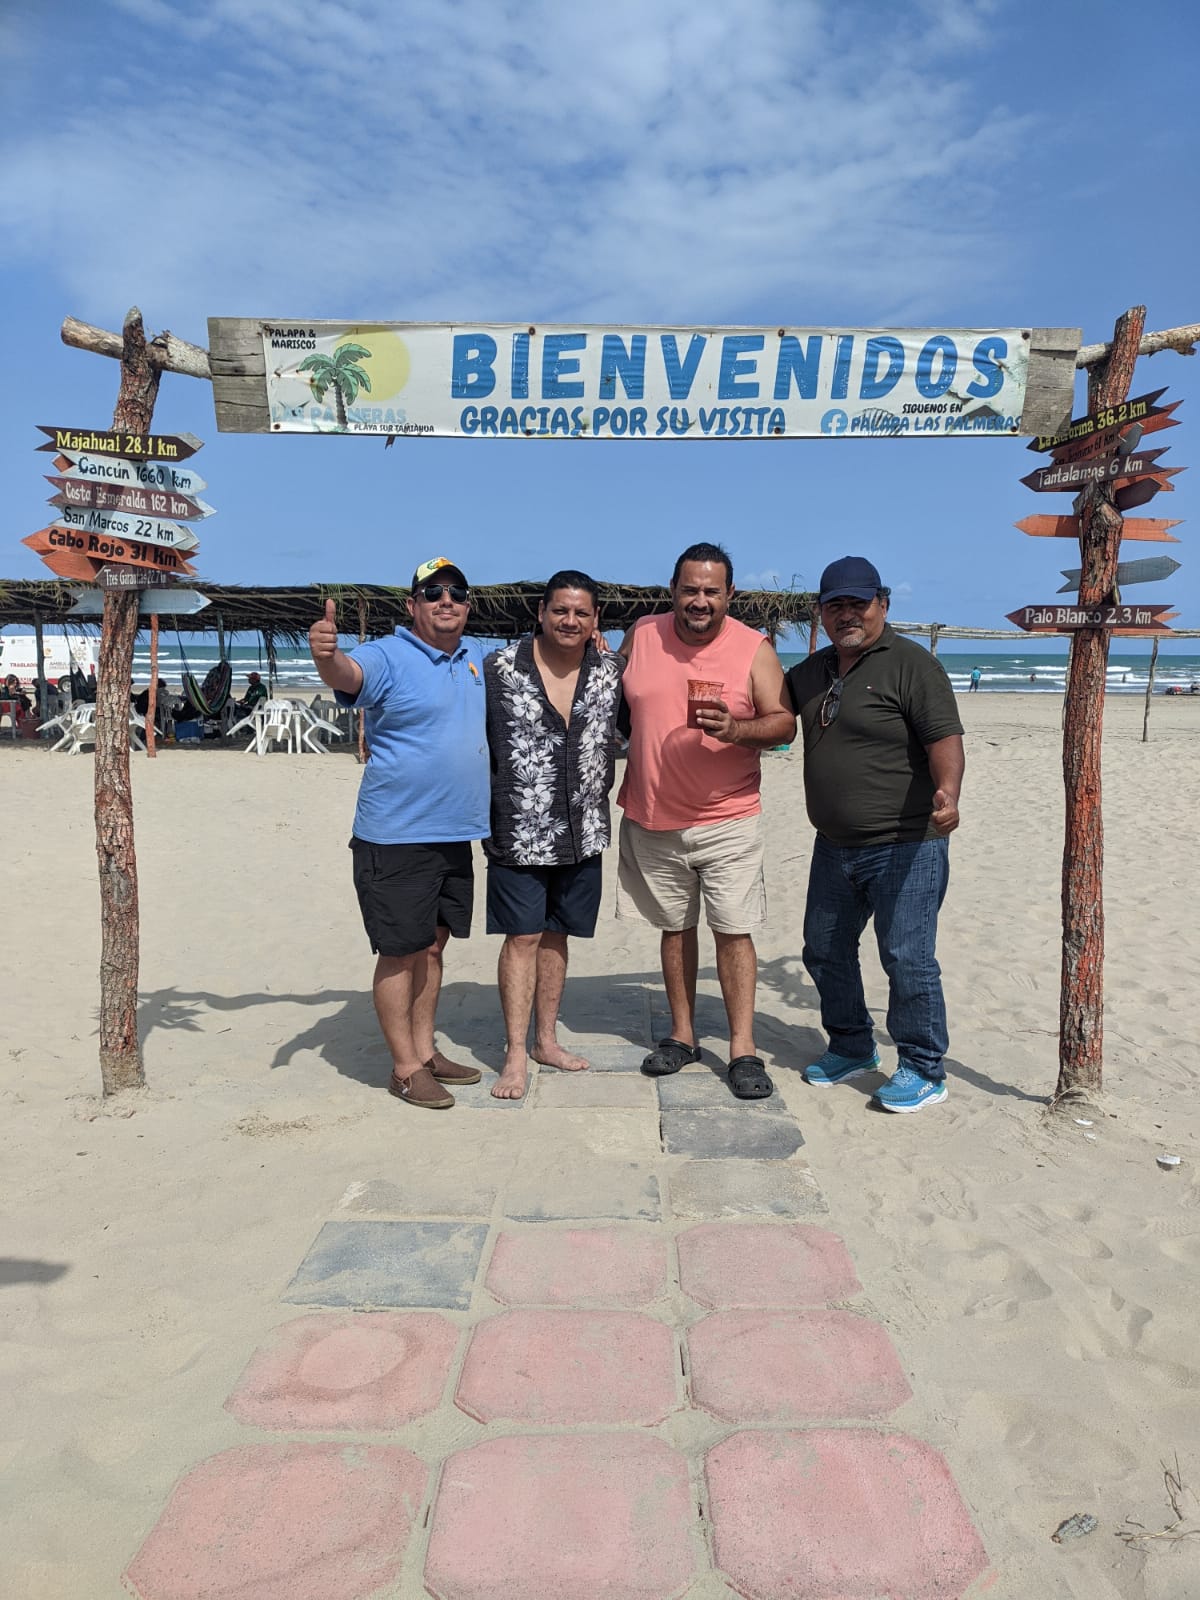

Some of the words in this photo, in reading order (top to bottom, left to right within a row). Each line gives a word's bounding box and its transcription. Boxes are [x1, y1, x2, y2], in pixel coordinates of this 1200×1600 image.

[269, 329, 306, 338] PALAPA
[308, 330, 316, 338] &
[271, 339, 316, 349] MARISCOS
[451, 332, 1008, 400] BIENVENIDOS
[310, 406, 407, 424] PAMERAS
[902, 403, 947, 414] SIGUENOS
[950, 403, 964, 413] EN
[1097, 405, 1127, 430] 36.2
[1129, 401, 1148, 419] km
[354, 423, 377, 431] PLAYA
[379, 424, 394, 432] SUR
[460, 405, 584, 436] GRACIAS
[592, 405, 648, 436] POR
[655, 405, 689, 436] SU
[699, 406, 786, 436] VISITA
[850, 416, 910, 433] PALAPA
[914, 416, 940, 431] LAS
[944, 415, 1022, 431] PALMERAS
[56, 431, 120, 452] Majahual
[125, 435, 153, 455] 28.1
[158, 438, 178, 457] km
[78, 456, 129, 480] Cancún
[136, 466, 165, 484] 1660
[172, 470, 192, 489] km
[1109, 458, 1119, 476] 6
[1124, 456, 1142, 473] km
[65, 482, 91, 501] Costa
[96, 486, 146, 510] Esmeralda
[151, 493, 167, 512] 162
[171, 498, 188, 517] km
[63, 506, 84, 526] San
[89, 511, 128, 533] Marcos
[134, 520, 152, 537] 22
[157, 523, 174, 542] km
[48, 529, 84, 549] Cabo
[88, 535, 124, 557] Rojo
[130, 543, 147, 561] 31
[104, 569, 118, 586] Tres
[1025, 607, 1053, 624] Palo
[1056, 607, 1101, 624] Blanco
[1106, 607, 1131, 624] 2.3
[1135, 607, 1151, 625] km
